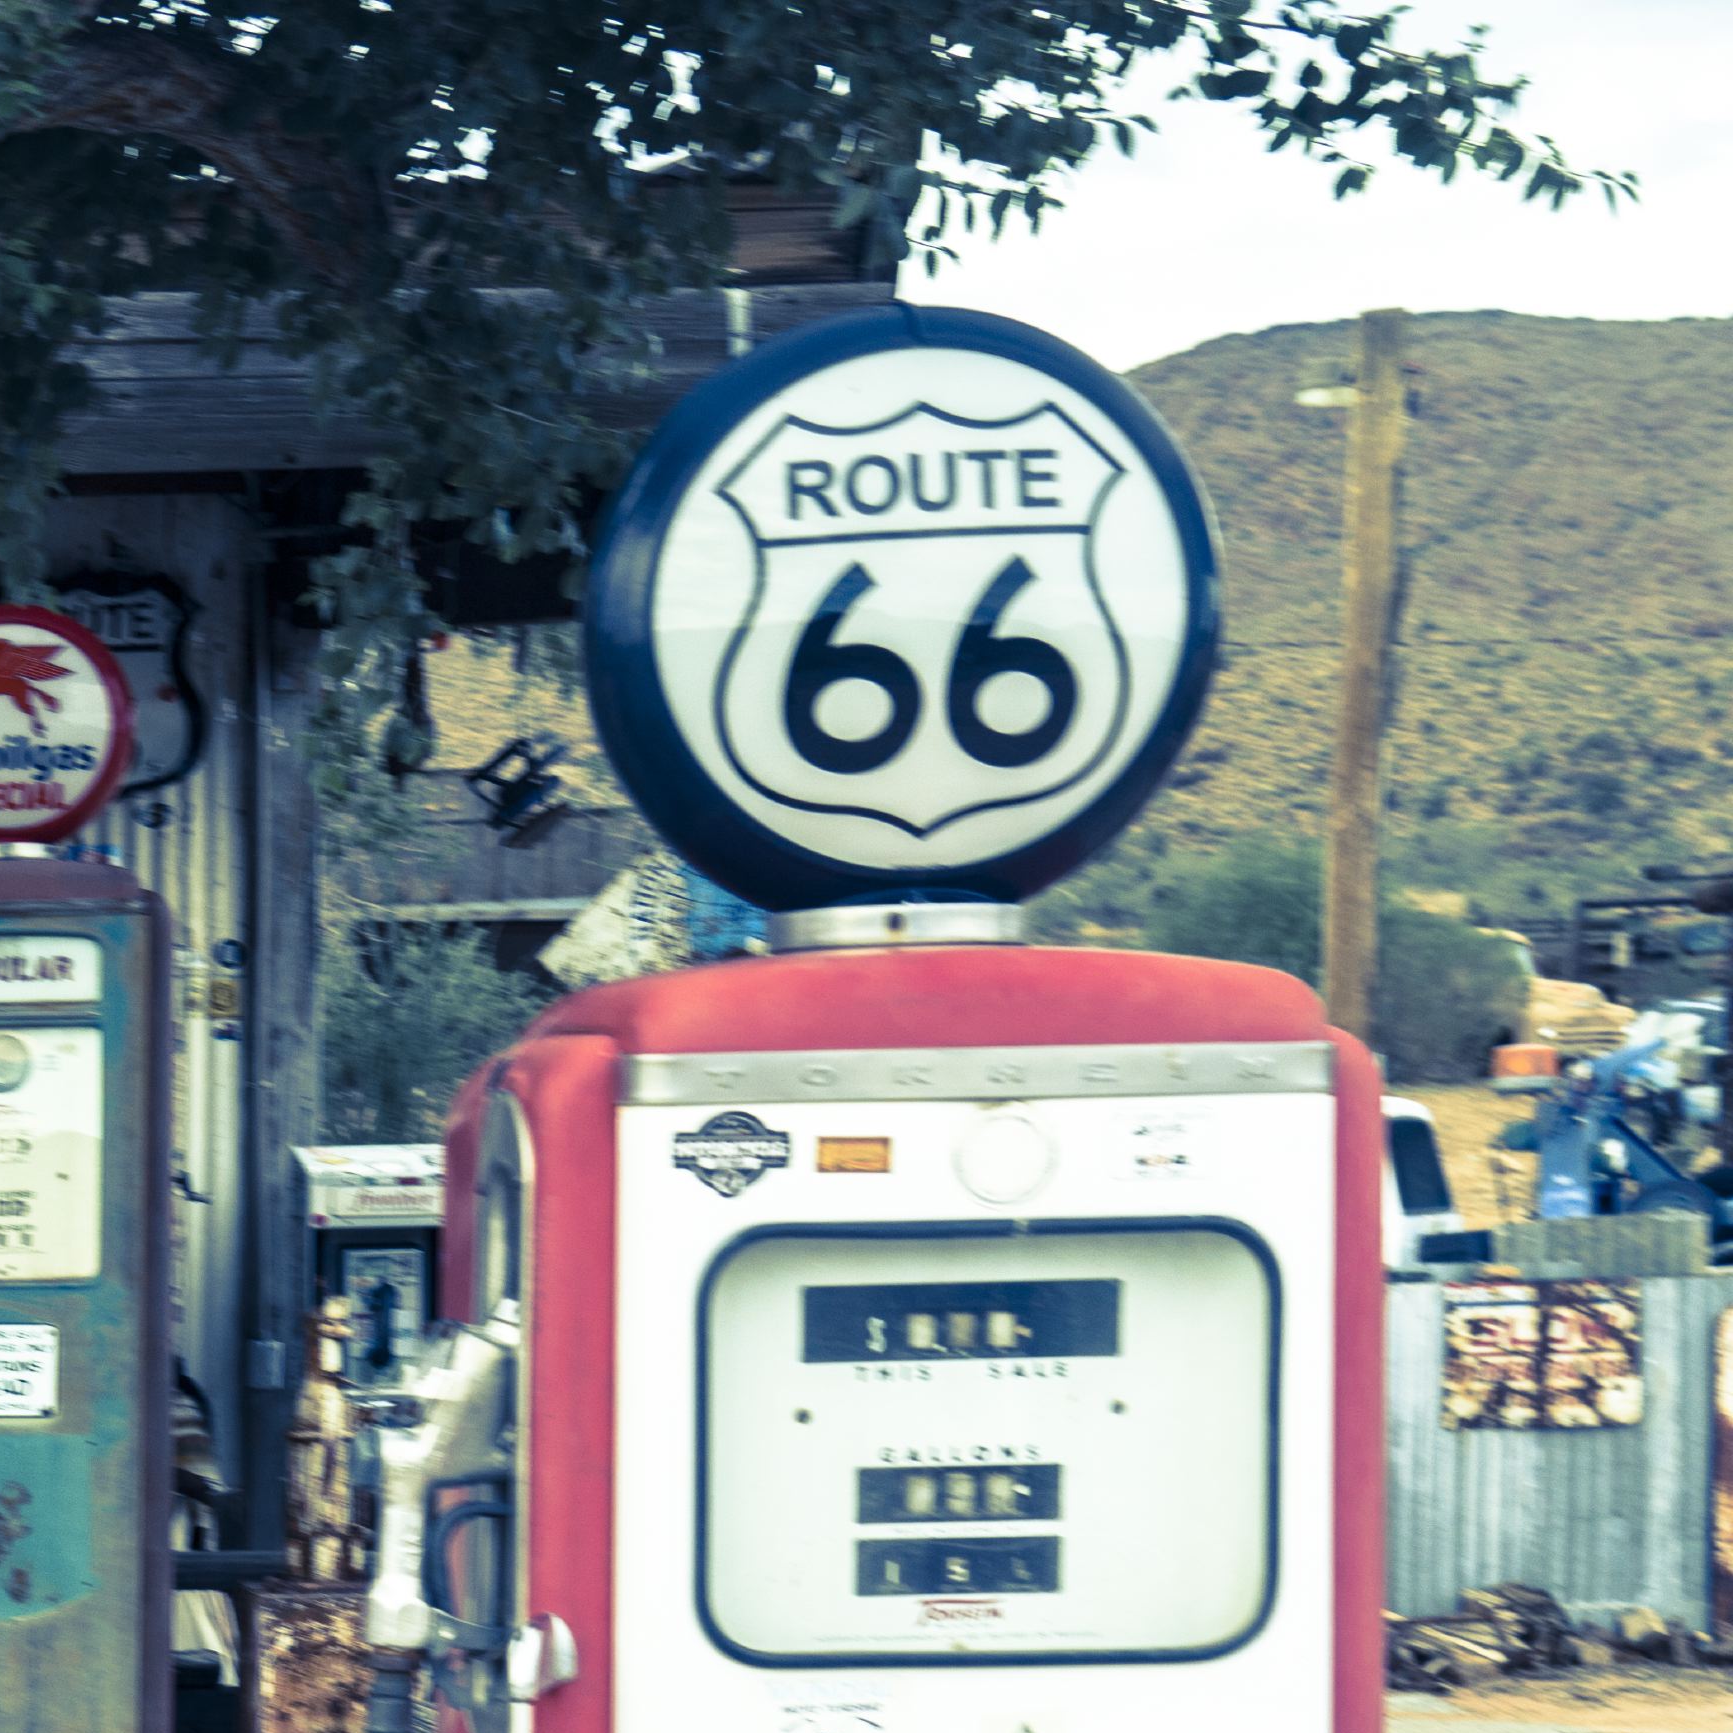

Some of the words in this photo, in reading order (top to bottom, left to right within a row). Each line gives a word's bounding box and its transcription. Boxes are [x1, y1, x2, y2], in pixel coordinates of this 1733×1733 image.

[785, 448, 1062, 520] ROUTE
[785, 553, 1080, 776] 66
[854, 1365, 935, 1382] THIS
[986, 1361, 1070, 1380] SALE
[878, 1444, 1043, 1464] GALLONS
